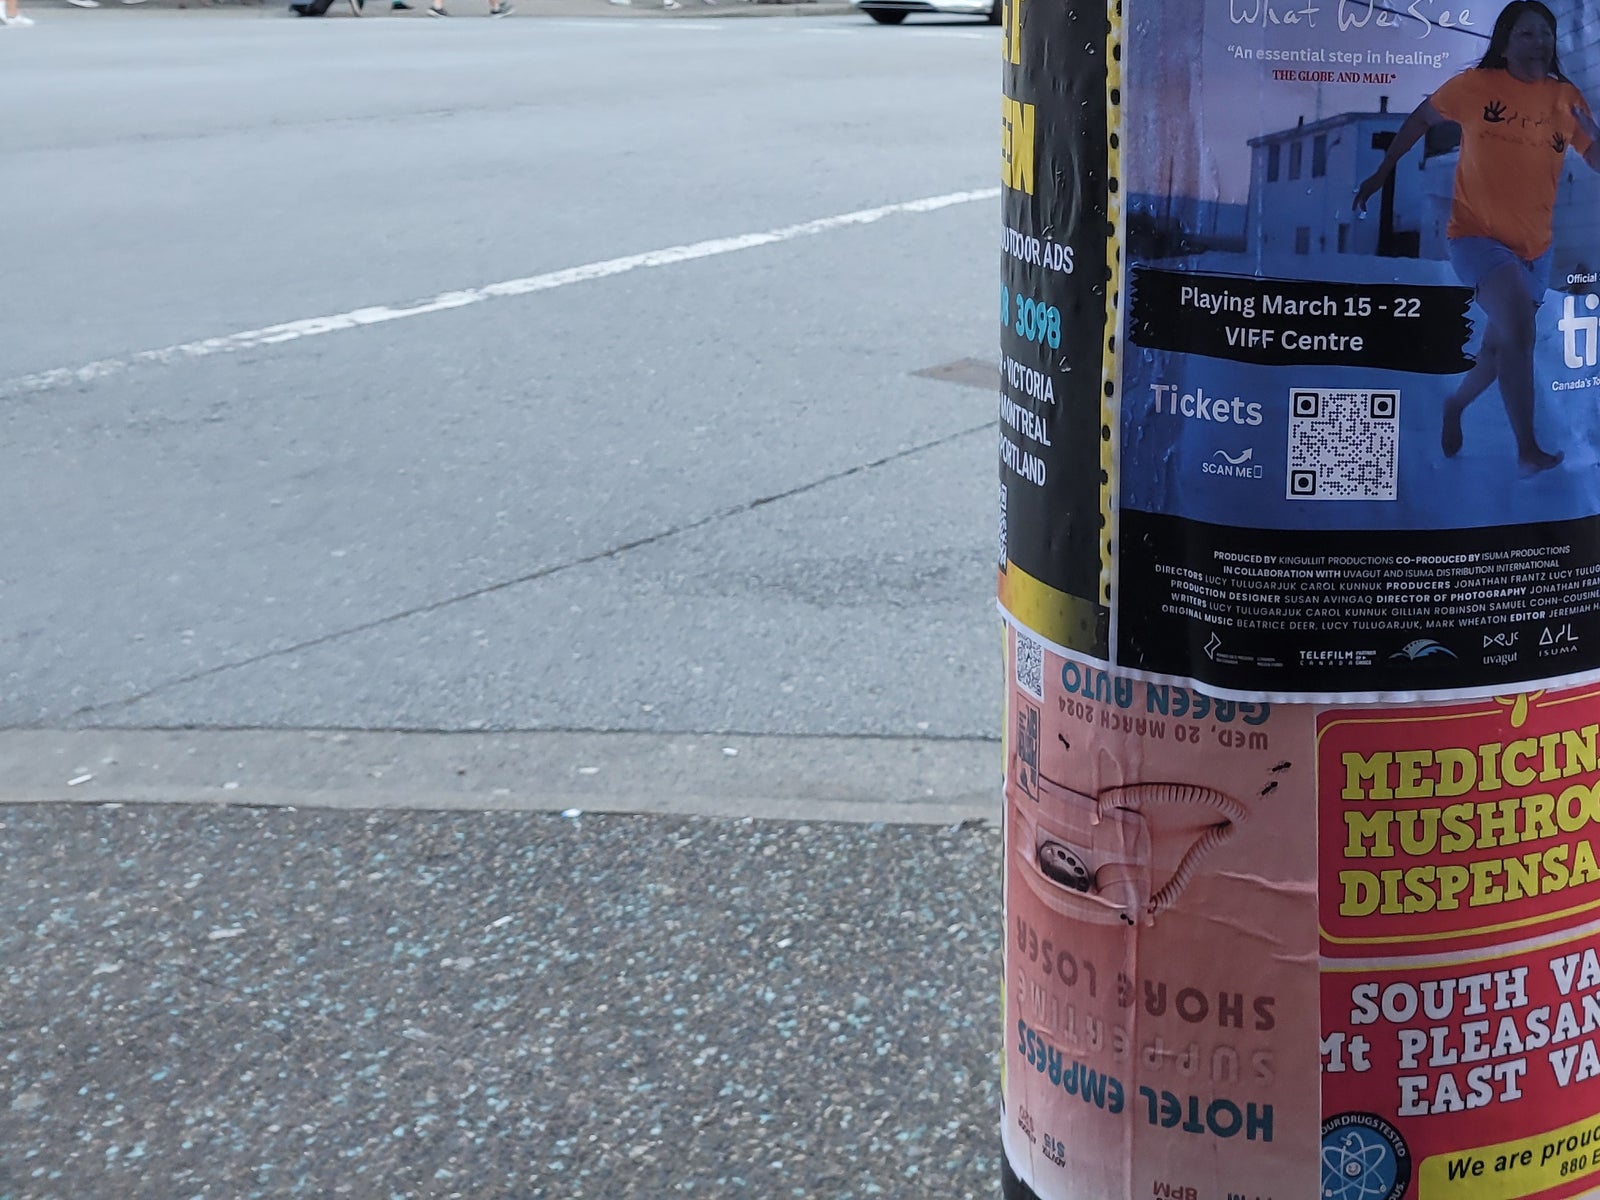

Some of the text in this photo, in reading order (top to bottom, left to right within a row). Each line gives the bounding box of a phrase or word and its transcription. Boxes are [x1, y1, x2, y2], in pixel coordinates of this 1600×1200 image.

[1255, 46, 1325, 62] essential
[1328, 49, 1363, 66] step
[1366, 49, 1382, 64] in
[1272, 69, 1296, 81] THE
[1297, 70, 1334, 82] GLOBE
[1336, 71, 1361, 83] AND
[1043, 241, 1074, 274] ADS
[1567, 273, 1597, 284] Official
[1181, 286, 1421, 318] Playing March 15 22
[1015, 293, 1061, 349] 3098
[1224, 326, 1364, 351] VIFF Centre
[1007, 355, 1056, 405] VICTORIA
[1000, 392, 1051, 446] MONTREAL
[1150, 384, 1263, 426] Tickets
[1202, 463, 1252, 478] SCAN ME
[1214, 545, 1571, 565] PRODUCED BY KINGULLIIT PRODUCTIONS CO-PRODUCED BY ISUMA PRODUCTIONS
[1223, 559, 1560, 578] IN COLLABORATION WITH UVAGUT AND ISUMA DISTRIBUTION INTERNATIONAL
[1170, 578, 1226, 599] PRODUCTION
[1229, 591, 1281, 603] DESIGNER
[1284, 595, 1320, 604] SUSAN
[1323, 595, 1373, 605] AVINGAQ
[1376, 594, 1430, 603] DIRECTOR
[1433, 593, 1448, 601] OF
[1450, 587, 1527, 601] PHOTOGRAPHY
[1530, 580, 1580, 594] JONATHAN
[1161, 604, 1202, 620] ORIGINAL
[1204, 613, 1233, 626] MUSIC
[1236, 619, 1285, 630] BEATRICE
[1290, 621, 1318, 631] DEER,
[1321, 621, 1348, 630] LUCY
[1426, 619, 1455, 629] MARK
[1458, 614, 1507, 627] WHEATON
[1510, 610, 1546, 622] EDITOR
[1548, 604, 1591, 618] JEREMIAH
[1300, 650, 1353, 660] TELEFILM
[1483, 652, 1518, 666] uvagut
[1538, 645, 1578, 657] ISUMA
[1061, 661, 1133, 709] AUTO
[1058, 695, 1269, 750] WED, 20 MARCH 2024
[1016, 915, 1276, 1031] SHORE LOSER
[1350, 966, 1529, 1026] SOUTH
[1017, 965, 1276, 1088] SUPPERTIME
[1320, 1031, 1371, 1073] Mt
[1017, 1018, 1274, 1142] HOTEL EMPRESS
[1397, 1058, 1526, 1117] EAST
[1342, 1114, 1406, 1158] DRUGS TESTED
[1447, 1157, 1485, 1182] We
[1494, 1150, 1533, 1171] are
[1560, 1156, 1587, 1177] 880
